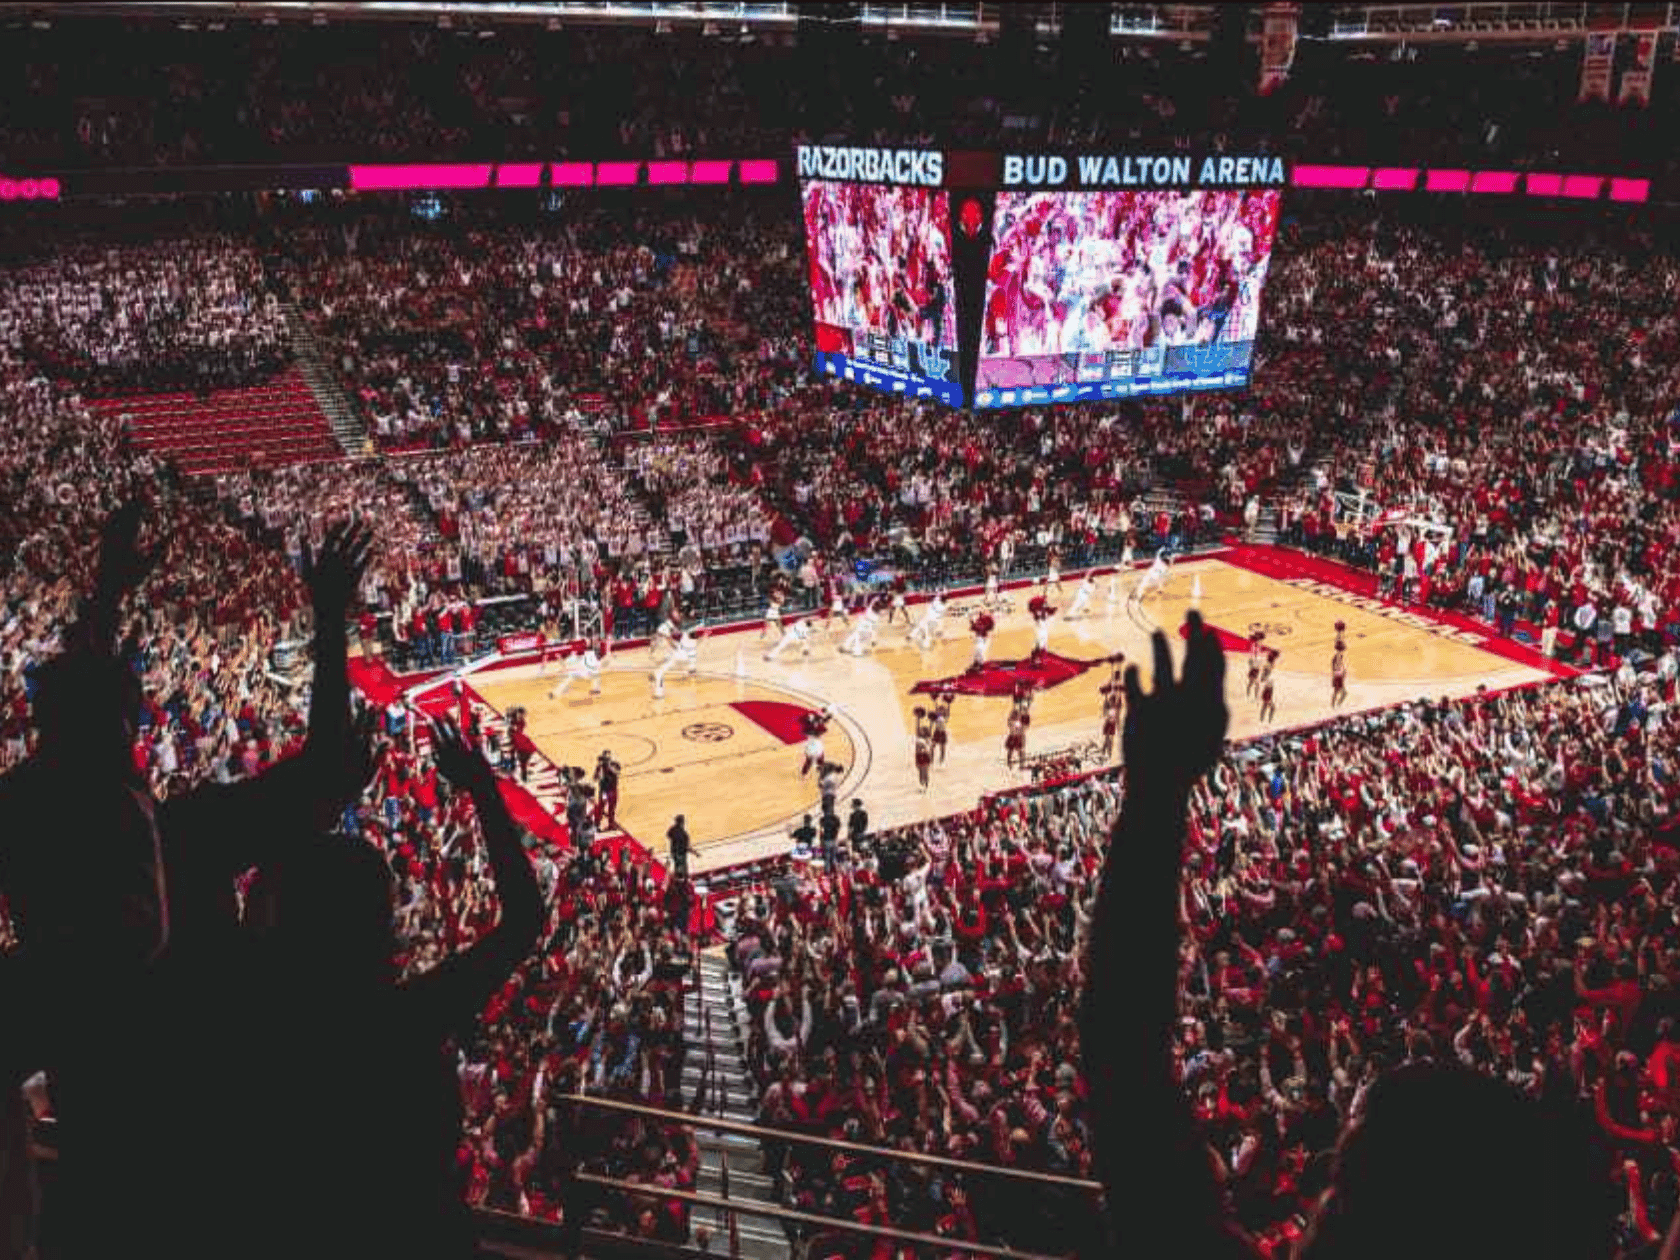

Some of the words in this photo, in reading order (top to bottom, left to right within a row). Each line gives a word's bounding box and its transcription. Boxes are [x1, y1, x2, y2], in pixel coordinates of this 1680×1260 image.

[797, 145, 943, 186] RAZORBACKS
[1003, 155, 1068, 185] BUD
[1078, 155, 1192, 185] WALTON
[1199, 157, 1285, 185] ARENA
